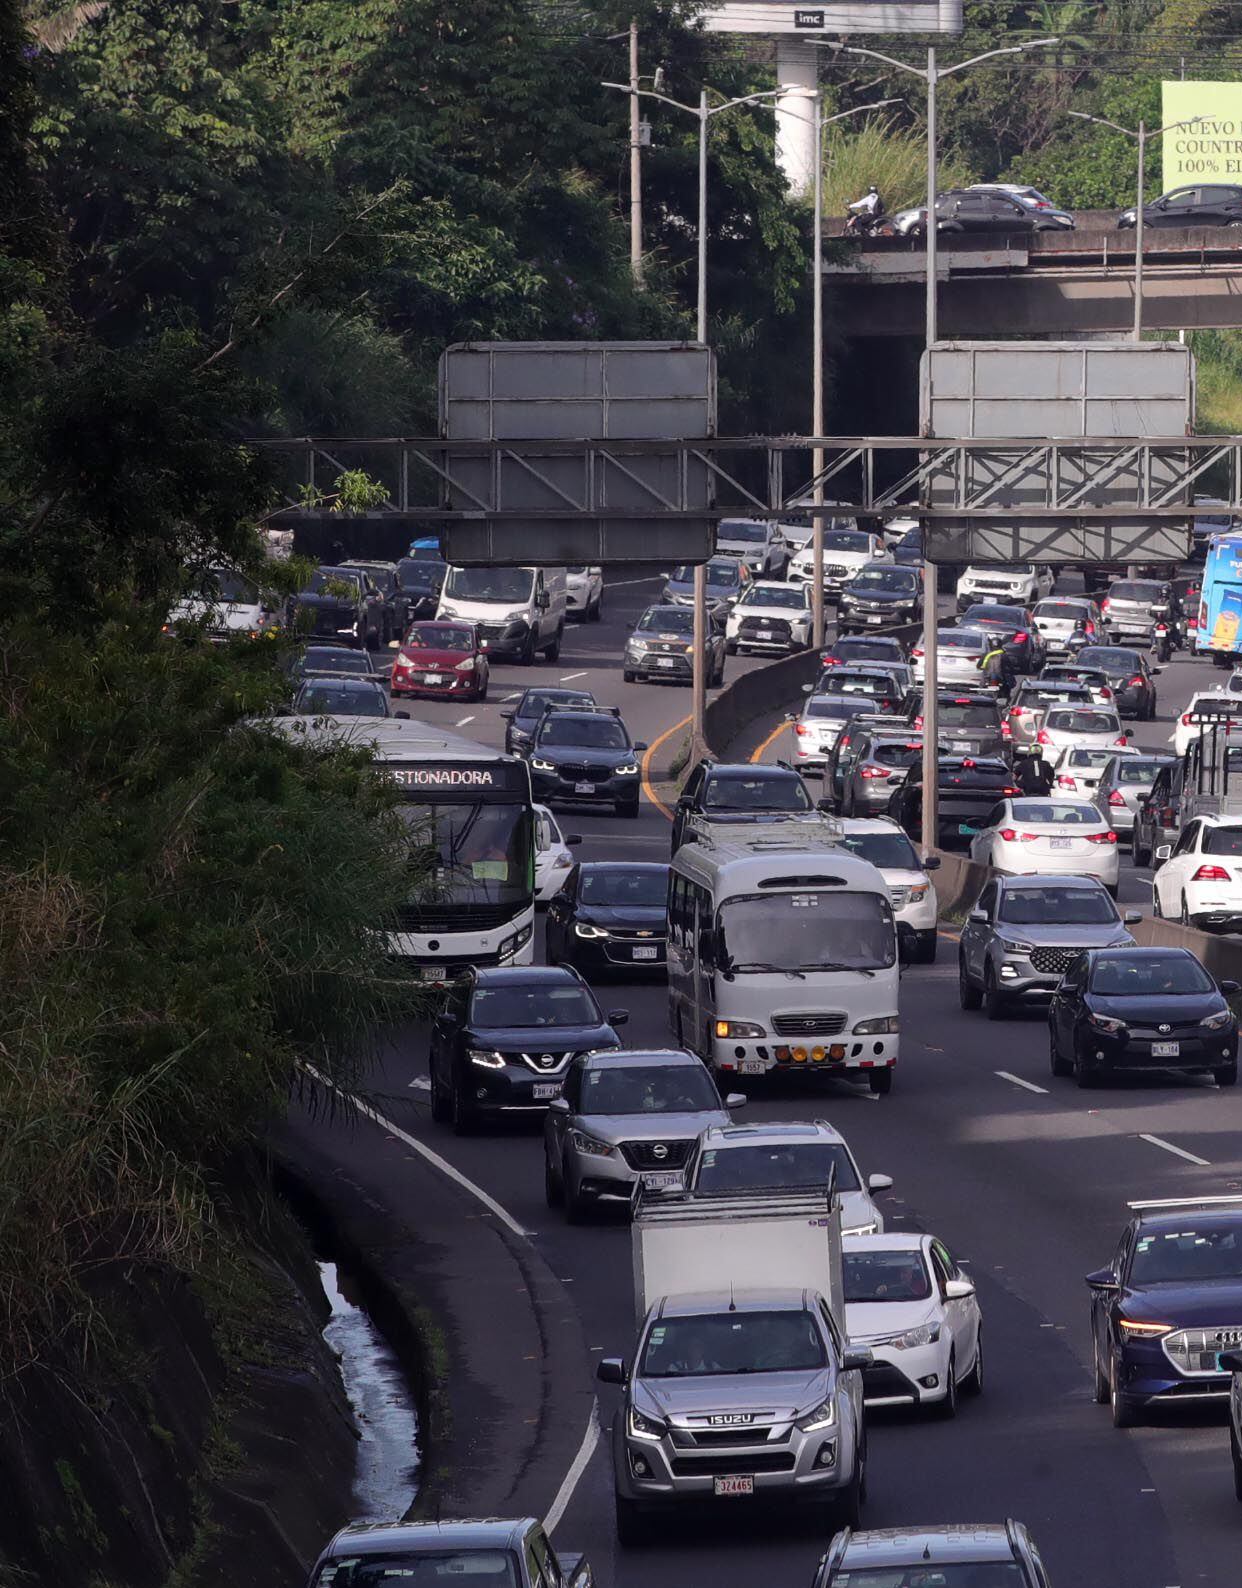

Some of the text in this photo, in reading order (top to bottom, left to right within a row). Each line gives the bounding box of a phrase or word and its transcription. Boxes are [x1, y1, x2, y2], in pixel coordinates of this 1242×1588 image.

[799, 12, 820, 24] imc
[1176, 121, 1234, 135] NUEVO
[1177, 159, 1220, 173] 100%
[710, 1414, 752, 1425] ISUZU
